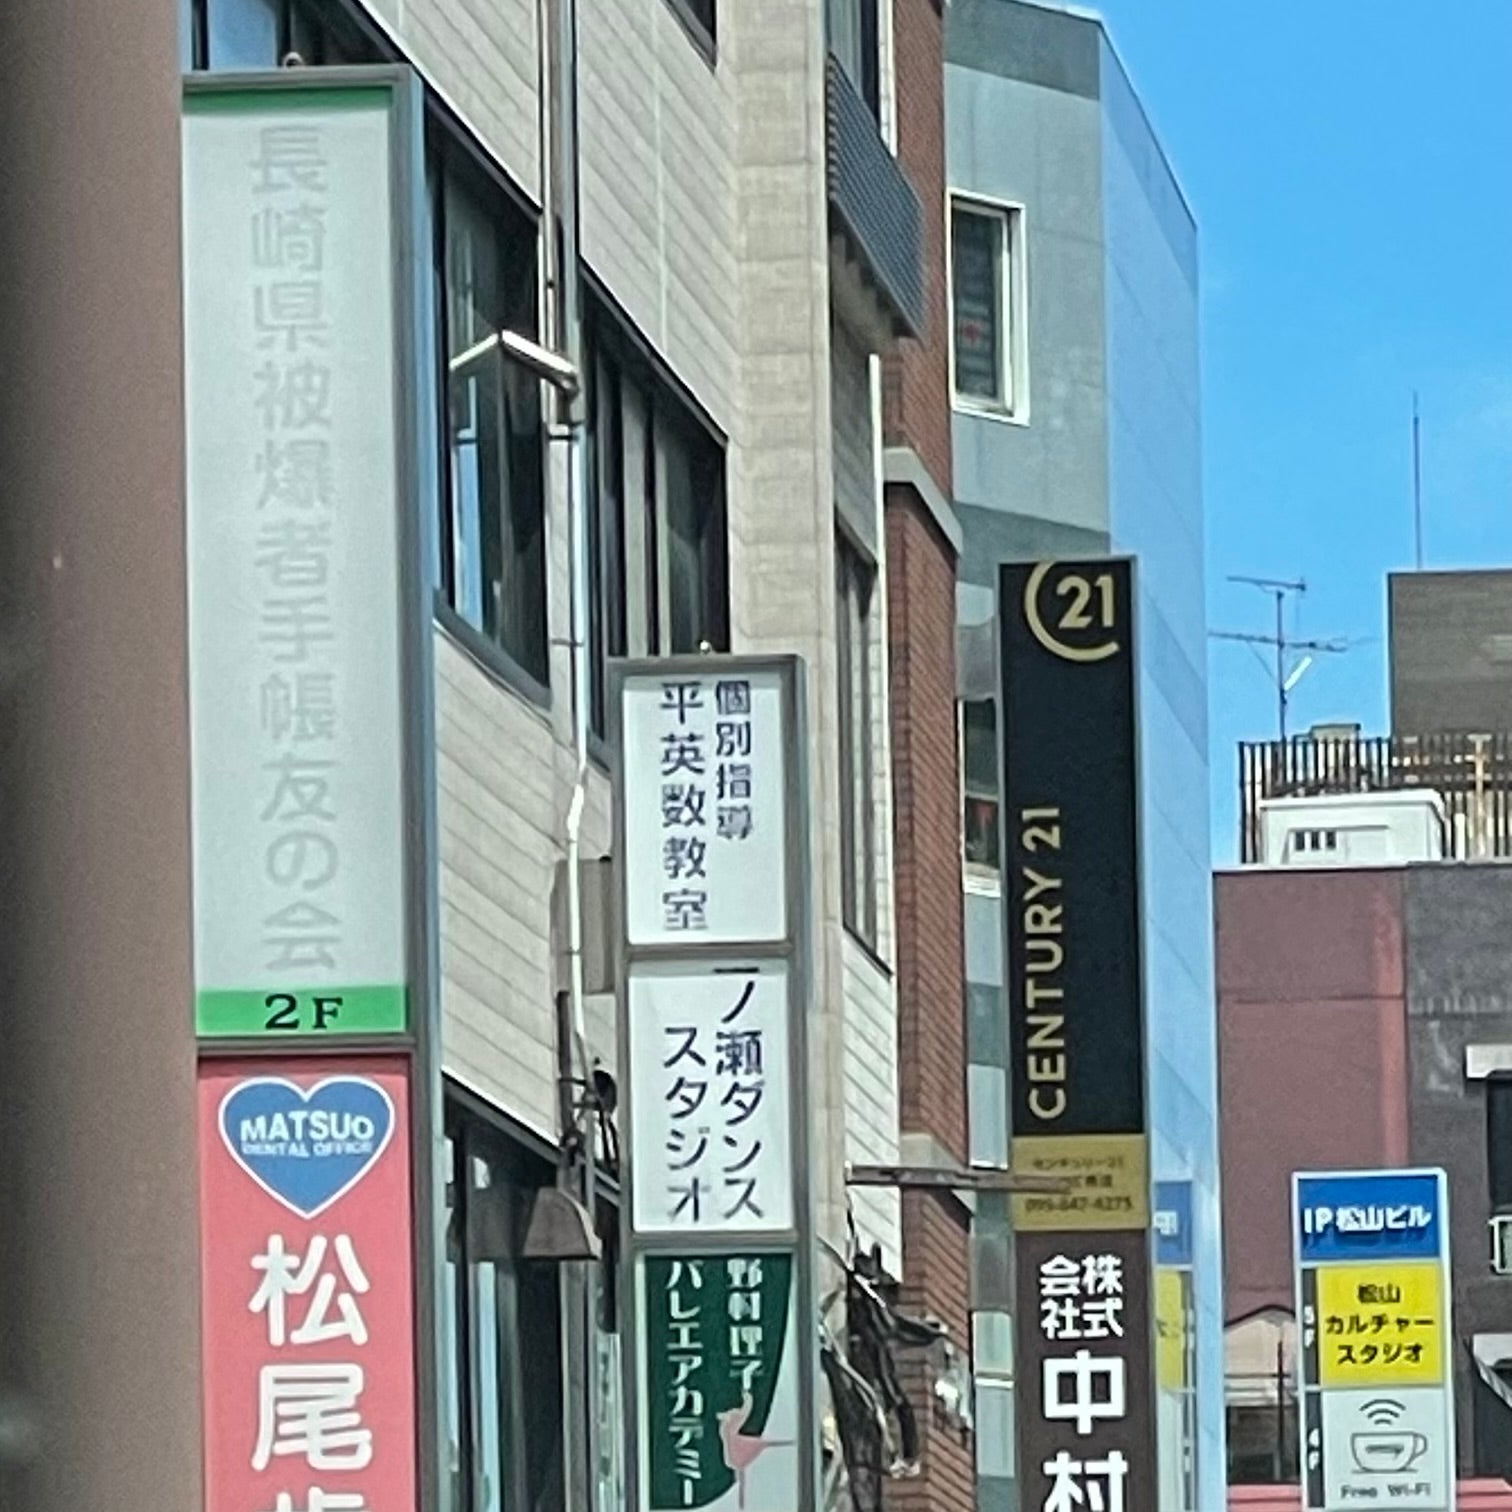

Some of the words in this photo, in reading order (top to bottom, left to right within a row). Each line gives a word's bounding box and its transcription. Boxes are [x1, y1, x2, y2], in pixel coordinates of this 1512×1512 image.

[248, 126, 343, 973] 長崎県被爆者手帳友の会
[659, 681, 707, 931] 平英数教室
[715, 680, 753, 840] 個別指導
[1022, 806, 1060, 850] 21
[264, 992, 344, 1031] 2F
[1027, 865, 1066, 1119] CENTURY
[240, 1110, 375, 1142] MATSUO
[663, 1026, 710, 1223] スタジオ
[714, 967, 764, 1220] 一ノ瀬ダンス
[666, 1259, 705, 1505] バレエアカデミー
[1326, 1314, 1435, 1335] カルチャー
[1337, 1344, 1423, 1365] スタジオ
